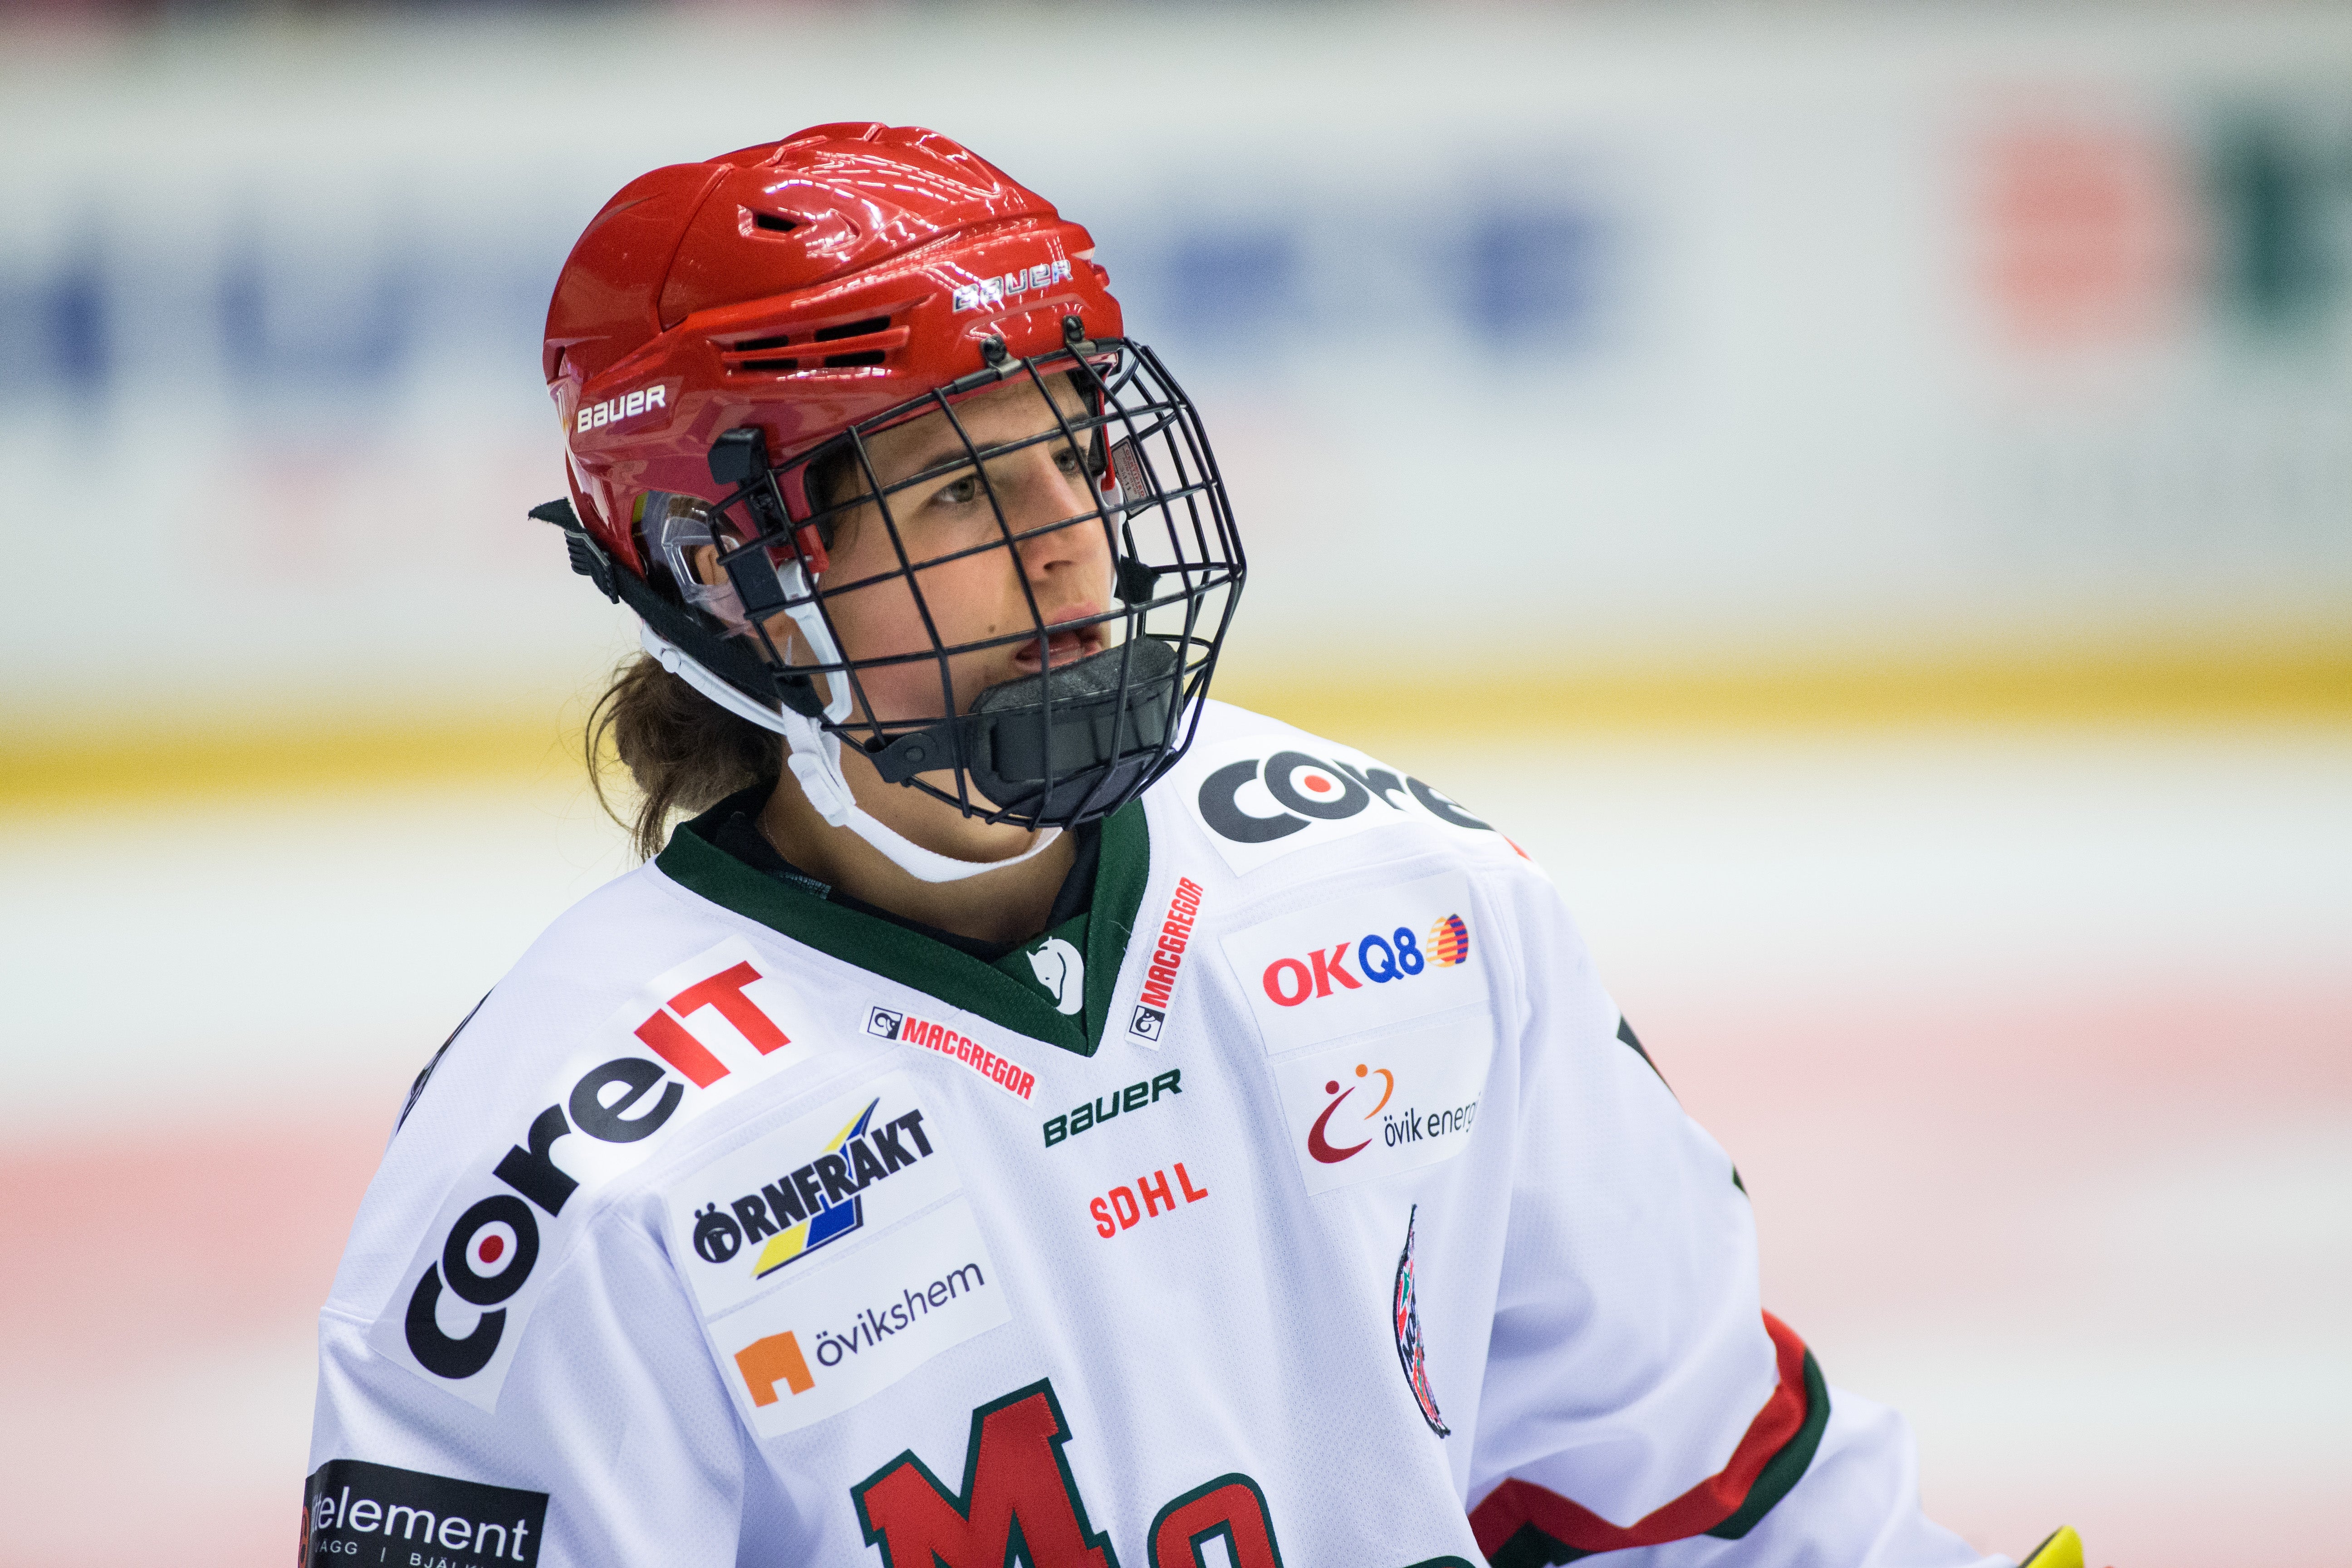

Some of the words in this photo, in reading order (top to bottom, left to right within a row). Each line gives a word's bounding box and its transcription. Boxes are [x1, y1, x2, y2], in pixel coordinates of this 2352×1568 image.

[953, 259, 1073, 314] BAUER
[577, 384, 666, 433] BAUER
[1140, 876, 1204, 1009] MACGREGOR
[1262, 926, 1425, 1007] OKQ8
[902, 1016, 1035, 1100] MACGREGOR
[1043, 1068, 1182, 1148] BAUER
[1384, 1107, 1423, 1147] övik
[693, 1108, 934, 1263] ÖRNFRAKT
[1090, 1162, 1208, 1239] SDHL
[816, 1263, 985, 1366] övikshem
